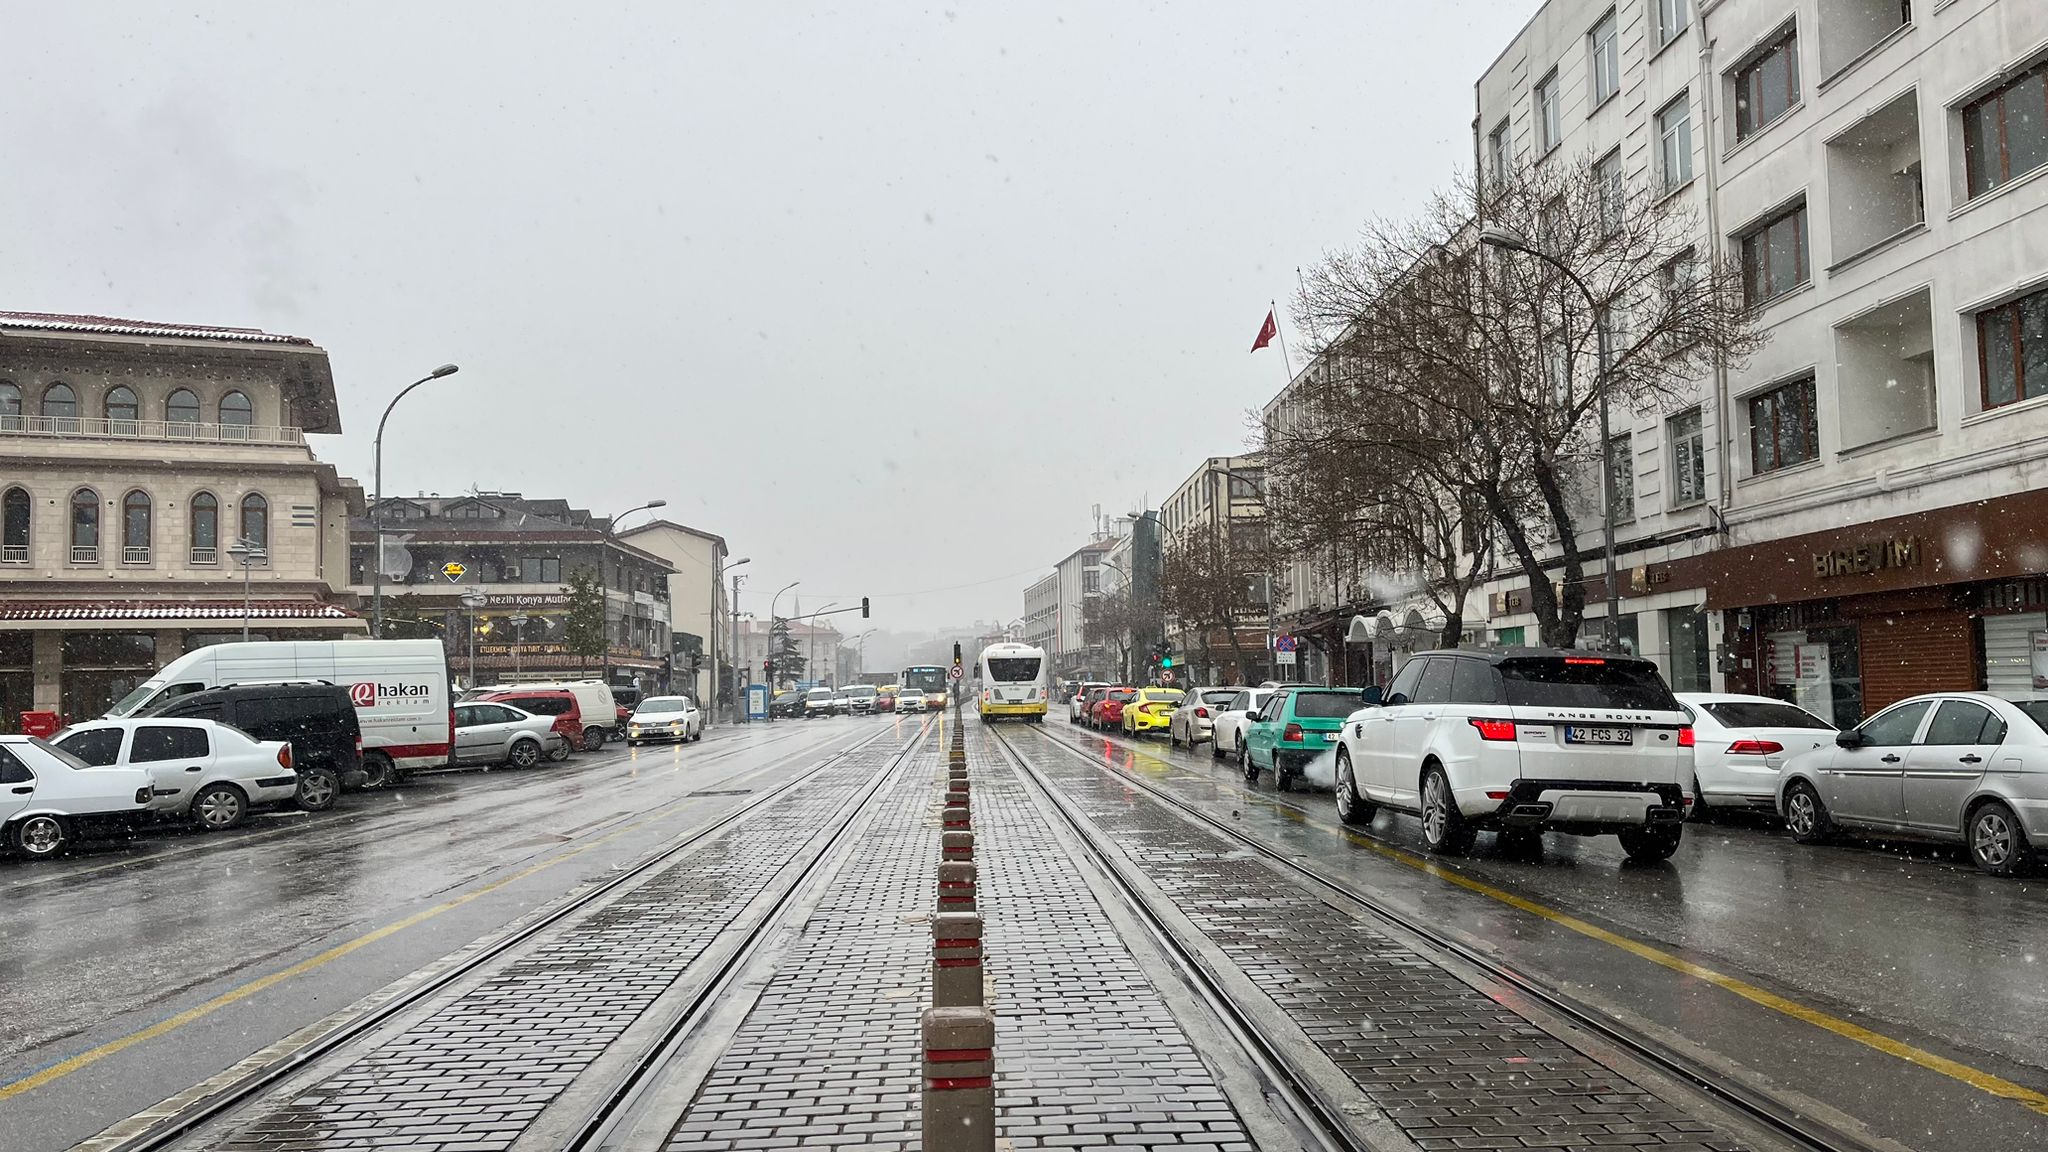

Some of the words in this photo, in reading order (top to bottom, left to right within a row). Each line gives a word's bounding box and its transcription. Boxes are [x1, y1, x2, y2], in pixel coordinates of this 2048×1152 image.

[516, 595, 543, 606] Konya
[377, 683, 429, 697] hakan
[1572, 729, 1586, 740] 42
[1591, 729, 1611, 740] FCS
[1617, 730, 1631, 741] 32
